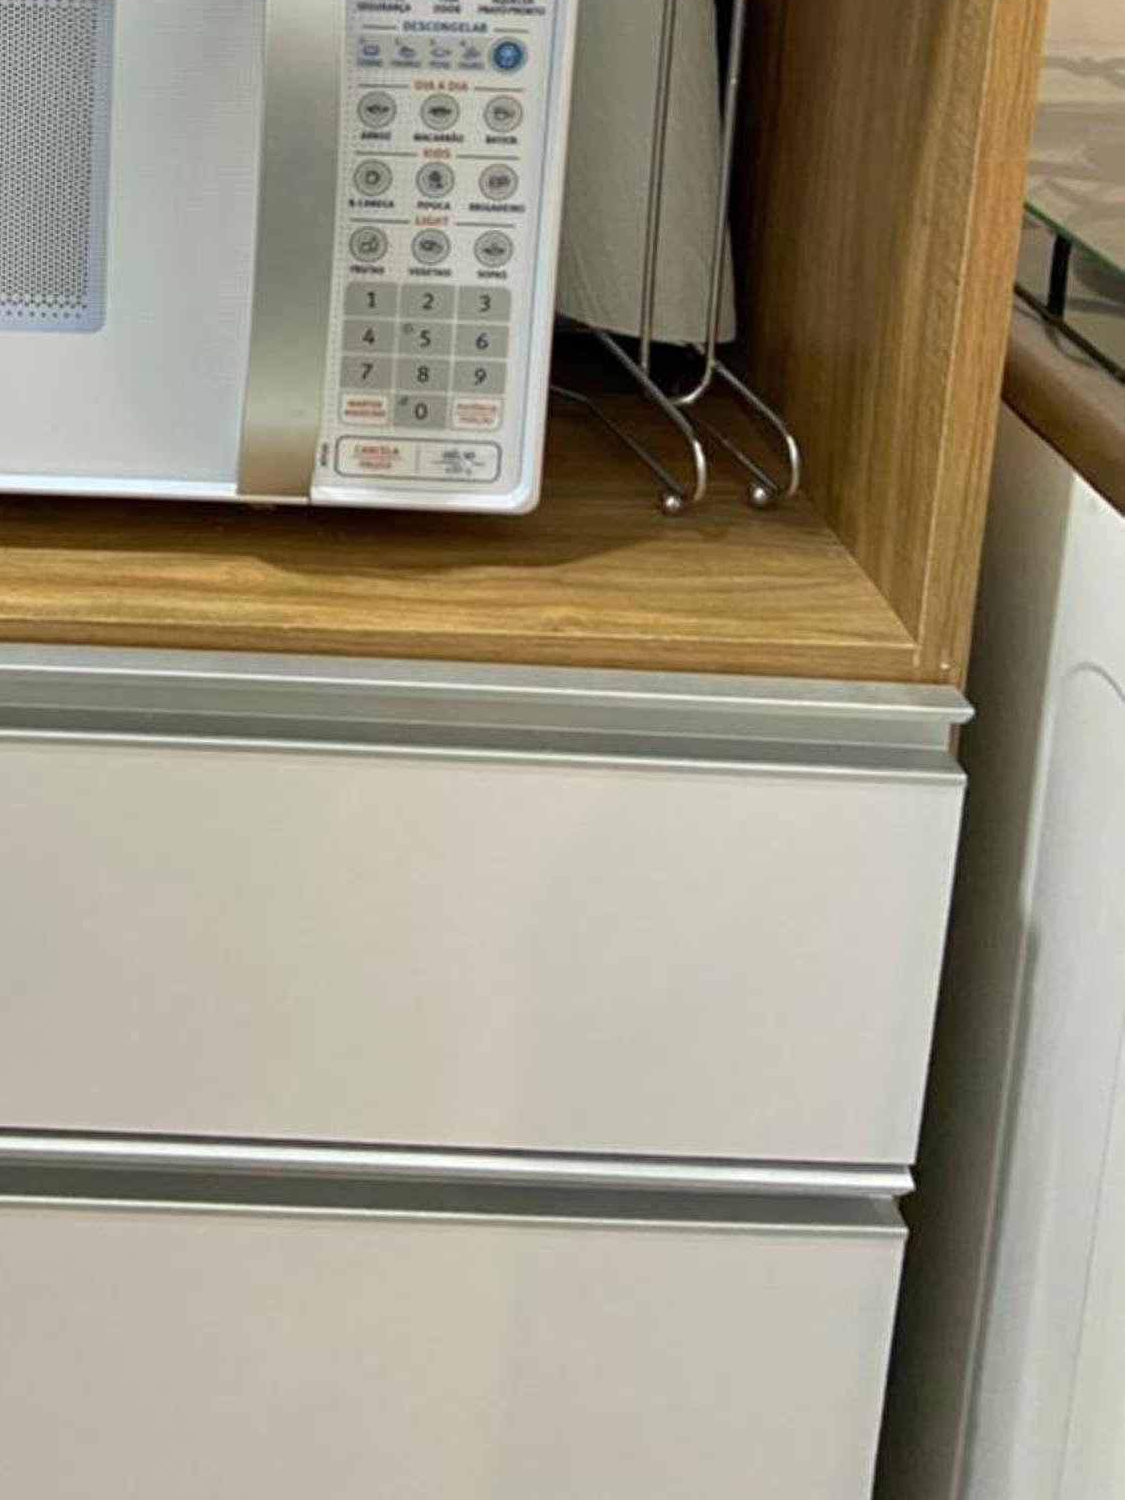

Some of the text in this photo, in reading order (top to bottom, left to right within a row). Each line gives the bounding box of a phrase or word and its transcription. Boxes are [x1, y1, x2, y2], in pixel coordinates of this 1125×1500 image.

[403, 21, 488, 32] DESCONGELAR
[366, 291, 376, 308] 1
[422, 293, 435, 310] 2
[478, 295, 491, 313] 3
[362, 328, 375, 344] 4
[419, 330, 431, 348] 5
[475, 332, 489, 350] 6
[361, 363, 374, 380] 7
[416, 366, 429, 383] 8
[474, 368, 487, 385] 9
[414, 403, 427, 421] 0
